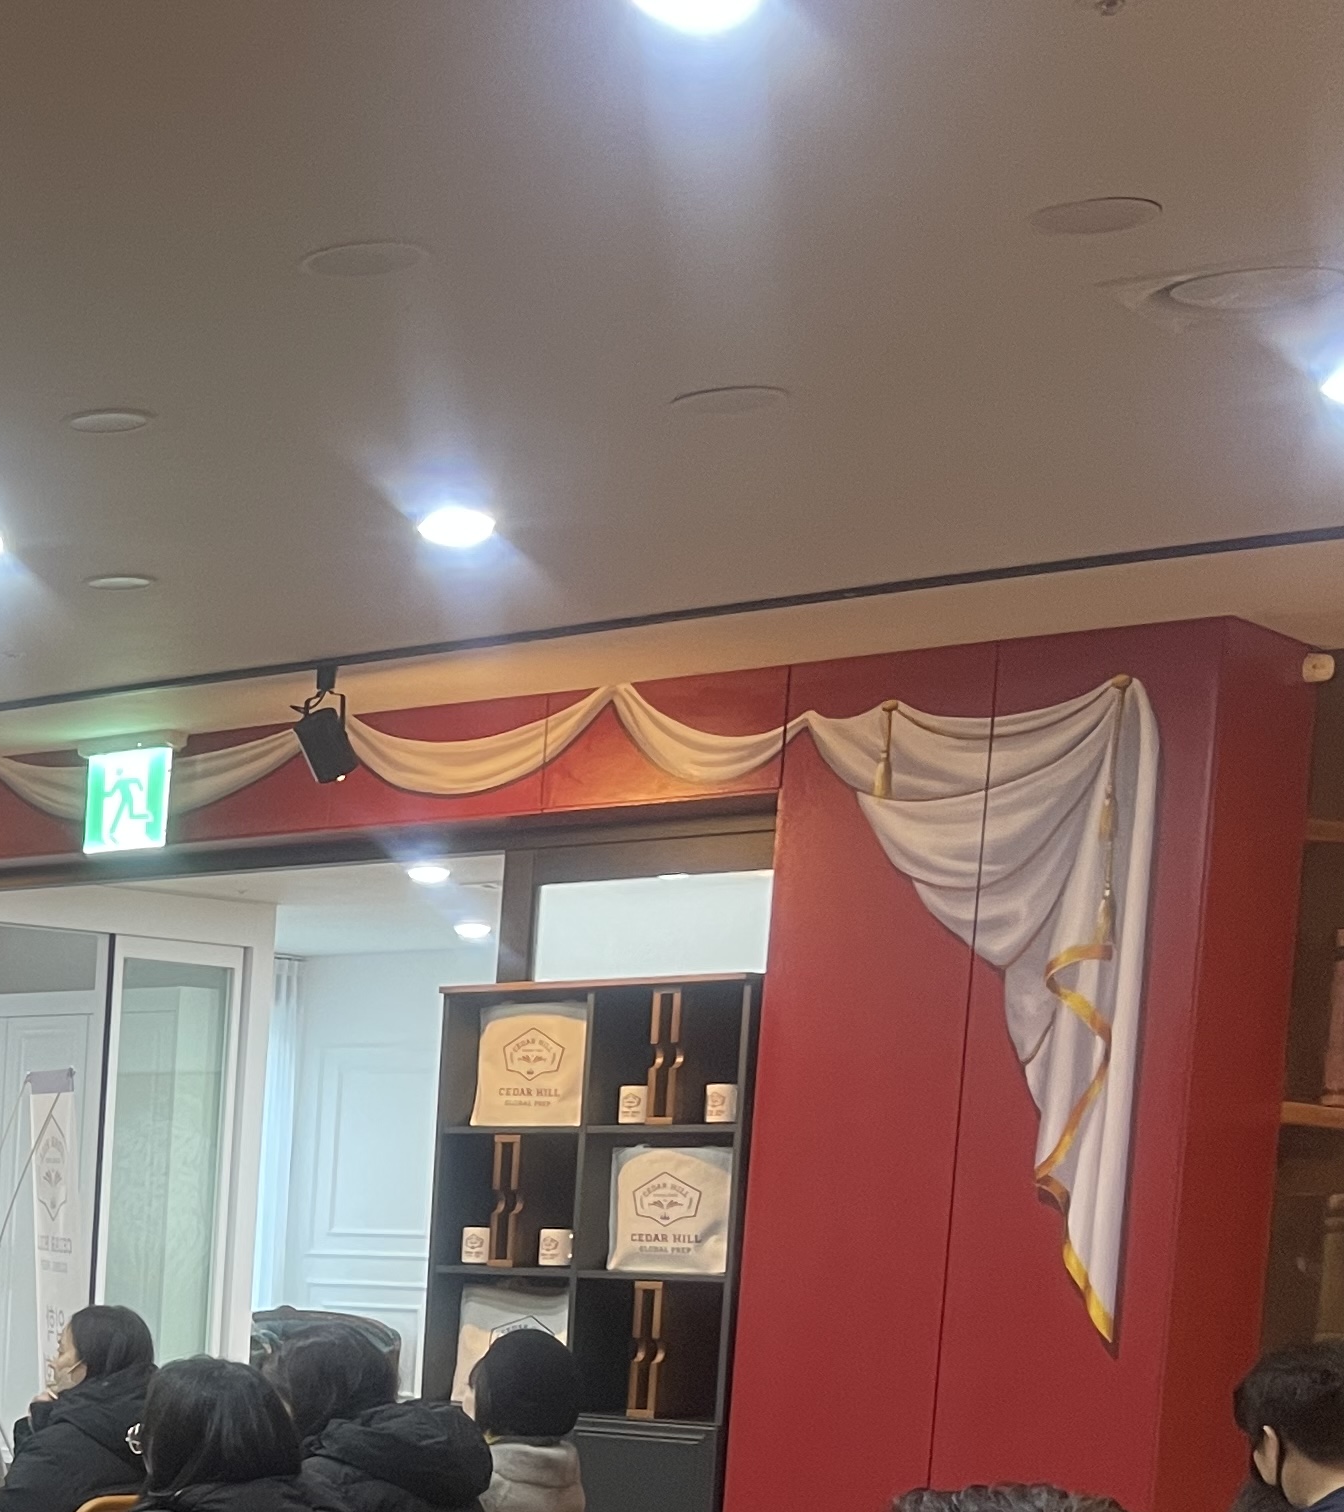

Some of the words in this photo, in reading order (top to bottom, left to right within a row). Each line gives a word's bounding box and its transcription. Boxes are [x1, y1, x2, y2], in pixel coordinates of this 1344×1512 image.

[498, 1088, 532, 1096] CEDAR
[536, 1088, 560, 1097] HILL
[643, 1183, 666, 1197] CEDAR
[670, 1184, 689, 1198] HILL
[631, 1233, 668, 1242] CEDAR
[673, 1234, 702, 1243] HILL
[639, 1245, 668, 1253] GLOBAL
